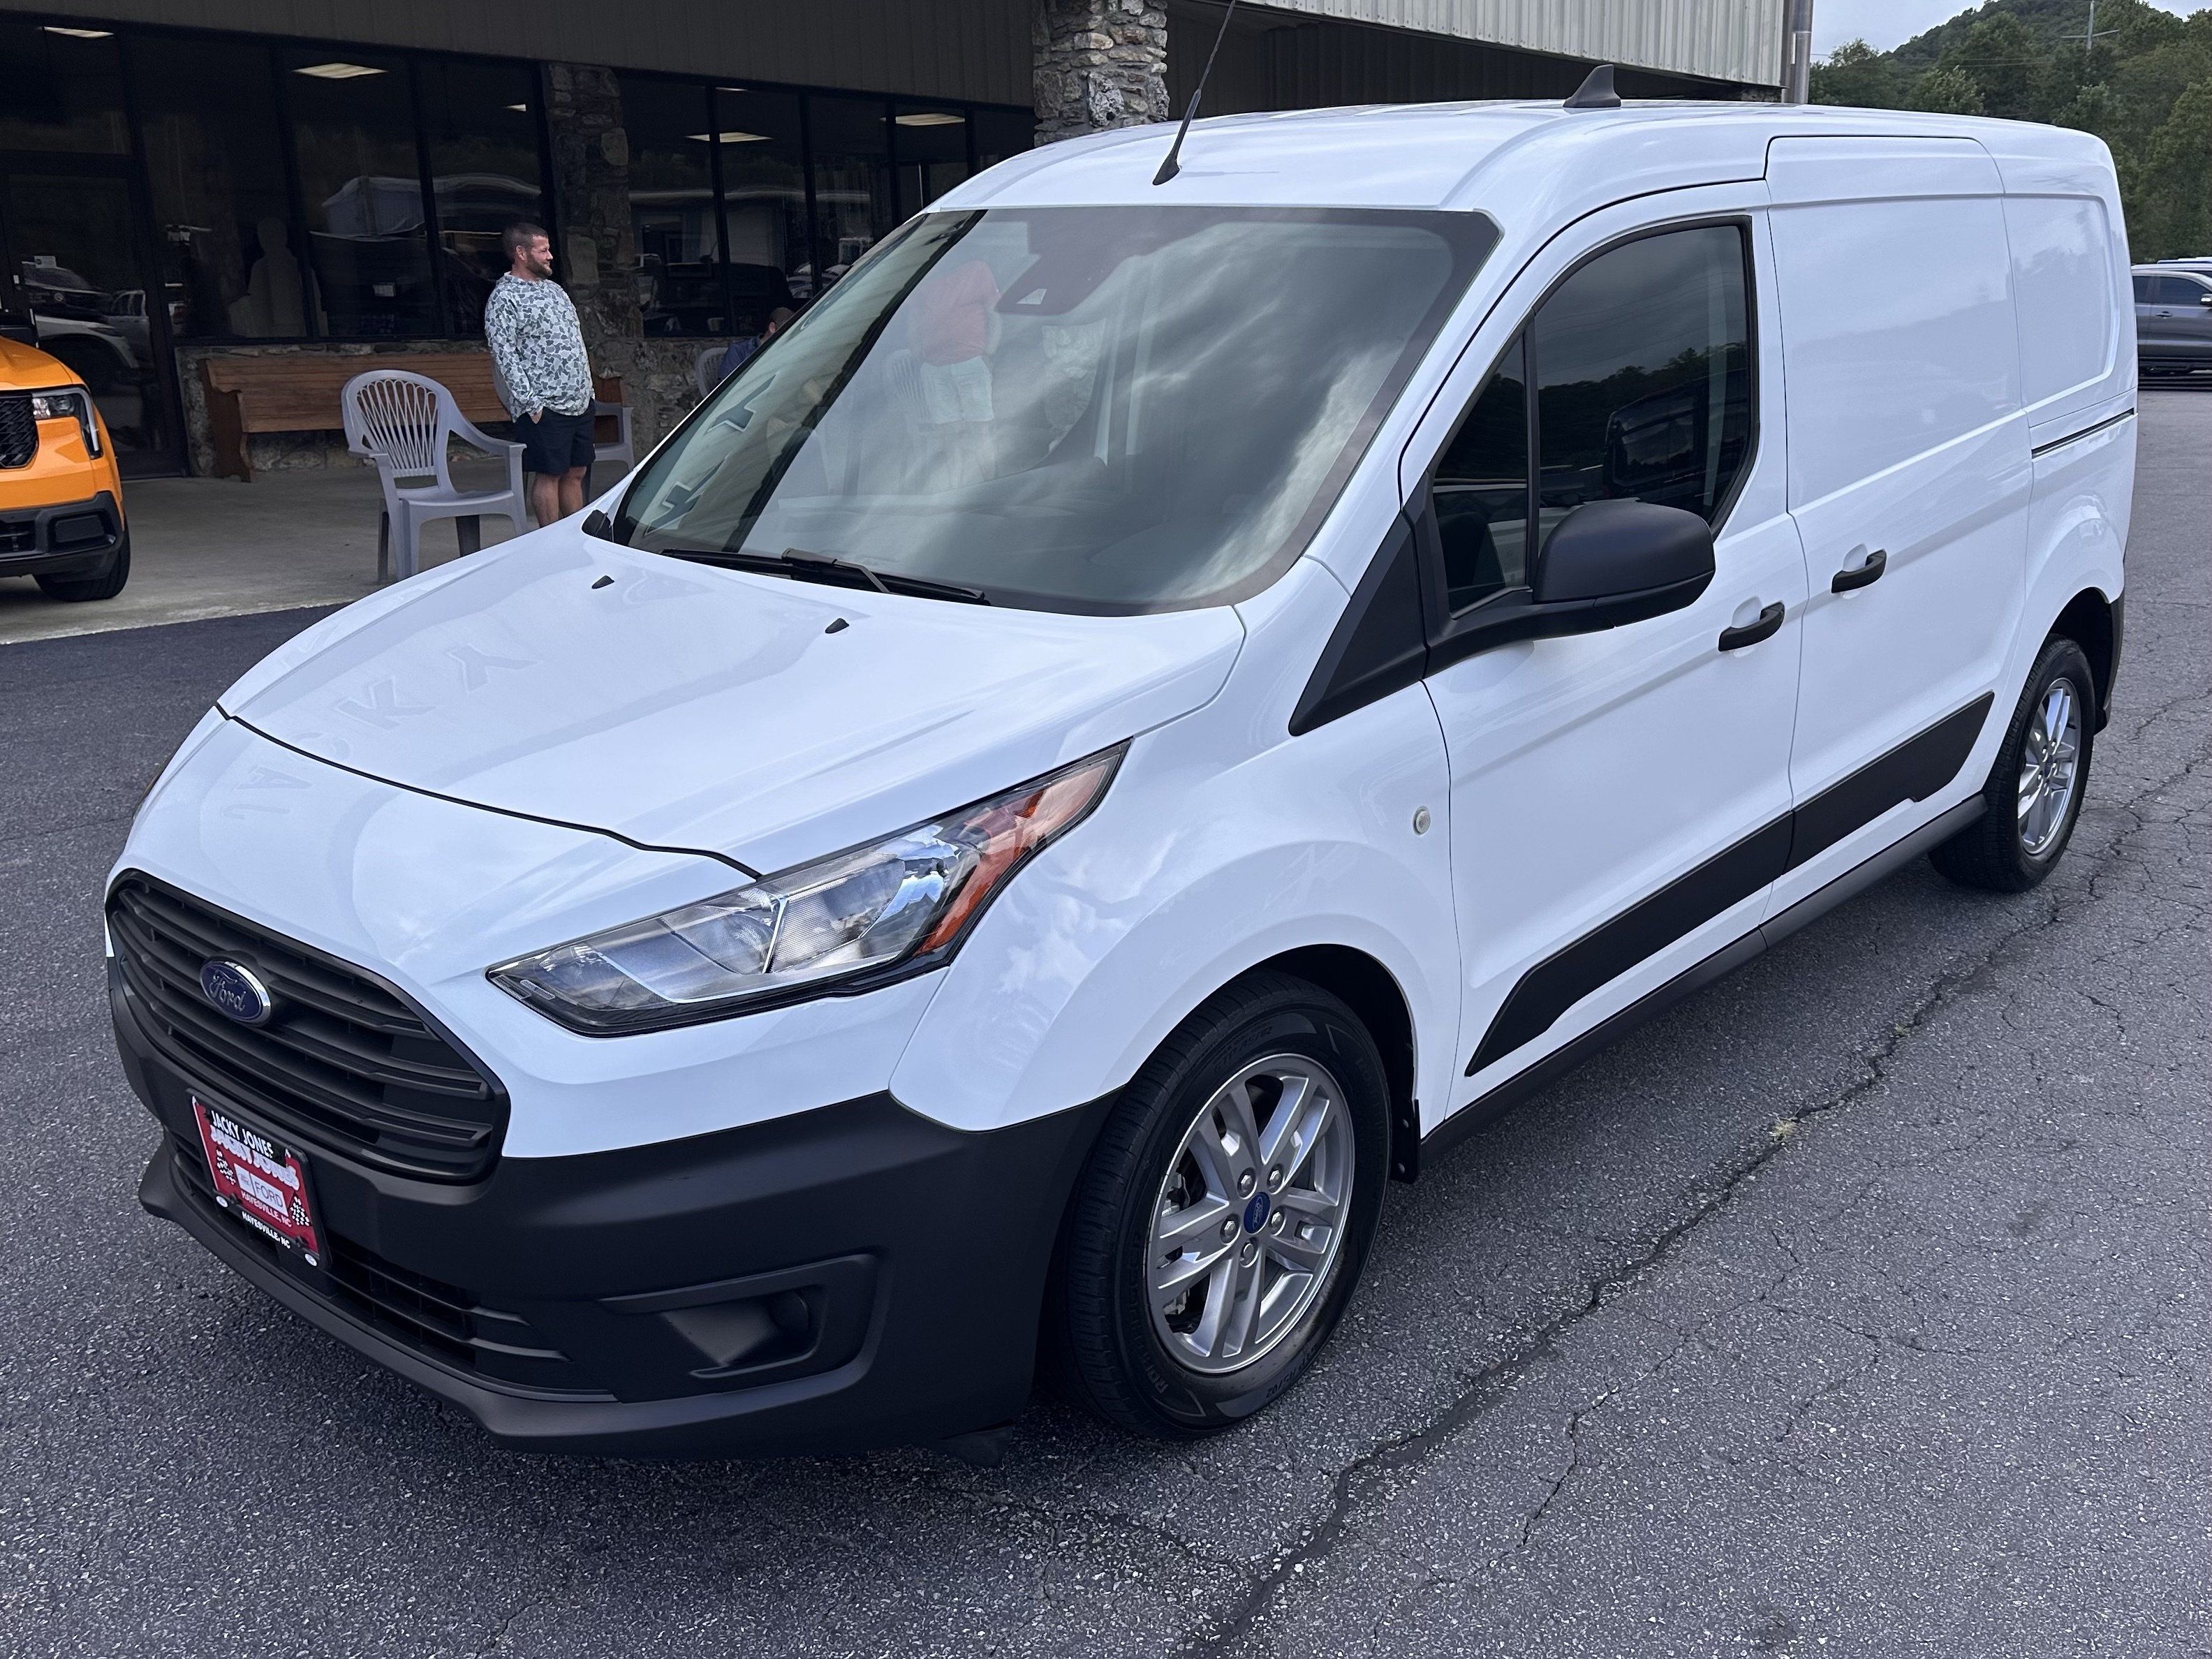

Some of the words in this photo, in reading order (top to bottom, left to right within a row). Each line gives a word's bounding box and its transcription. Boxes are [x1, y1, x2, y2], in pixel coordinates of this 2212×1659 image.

[209, 968, 246, 1012] Ford
[211, 1110, 240, 1141] JACKY
[242, 1128, 274, 1158] JONES
[254, 1181, 283, 1208] FORD
[281, 1215, 293, 1227] NC
[280, 1236, 291, 1249] NC
